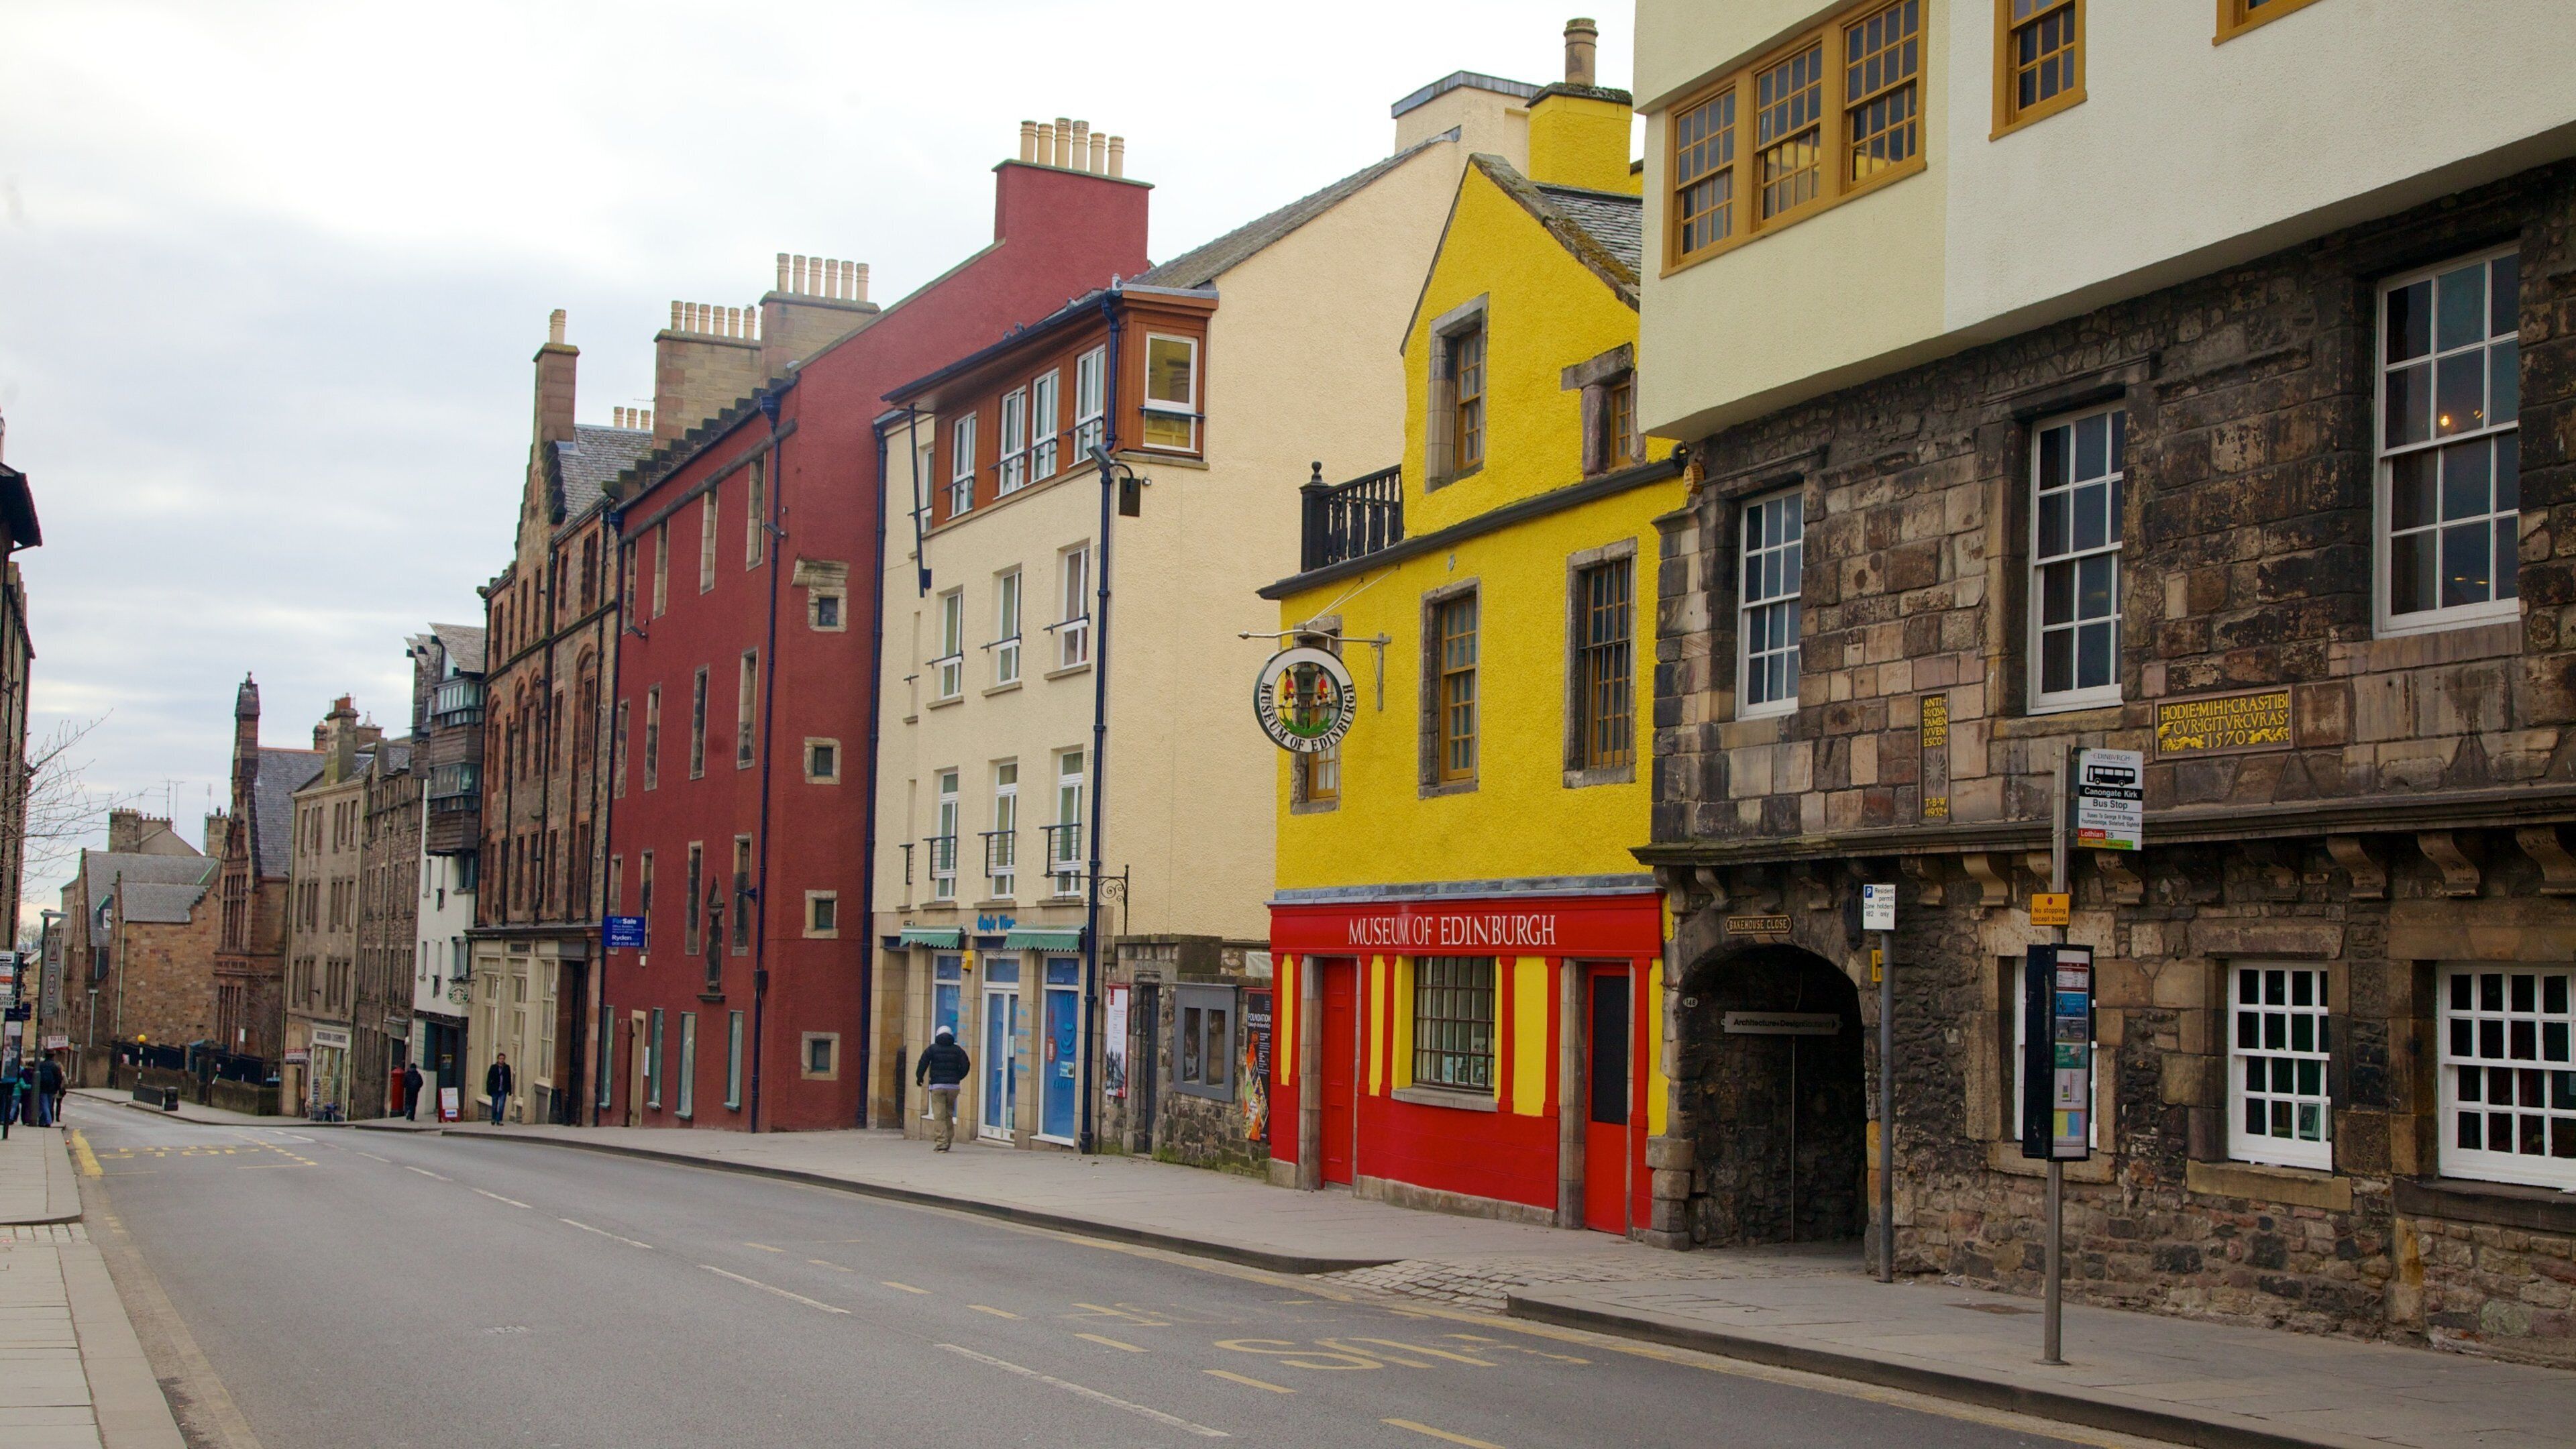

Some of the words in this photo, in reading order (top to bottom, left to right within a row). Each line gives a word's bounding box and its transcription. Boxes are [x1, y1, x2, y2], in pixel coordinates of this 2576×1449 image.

[1260, 682, 1289, 742] MUSEUM
[1290, 737, 1305, 751] OF
[1311, 684, 1354, 752] EDINBURGH
[1923, 716, 1947, 727] TAMEN
[2208, 730, 2246, 748] 1570
[2084, 787, 2121, 798] Canongate
[2124, 790, 2137, 798] Kirk
[2093, 799, 2108, 808] Bus
[2110, 800, 2128, 810] Stop
[2080, 830, 2104, 838] Lothian
[1348, 916, 1410, 945] MUSEUM
[1413, 916, 1433, 945] OF
[1440, 914, 1556, 946] EDINBURGH
[1729, 919, 1764, 930] BAKEHOUSE
[1766, 919, 1787, 930] CLOSE
